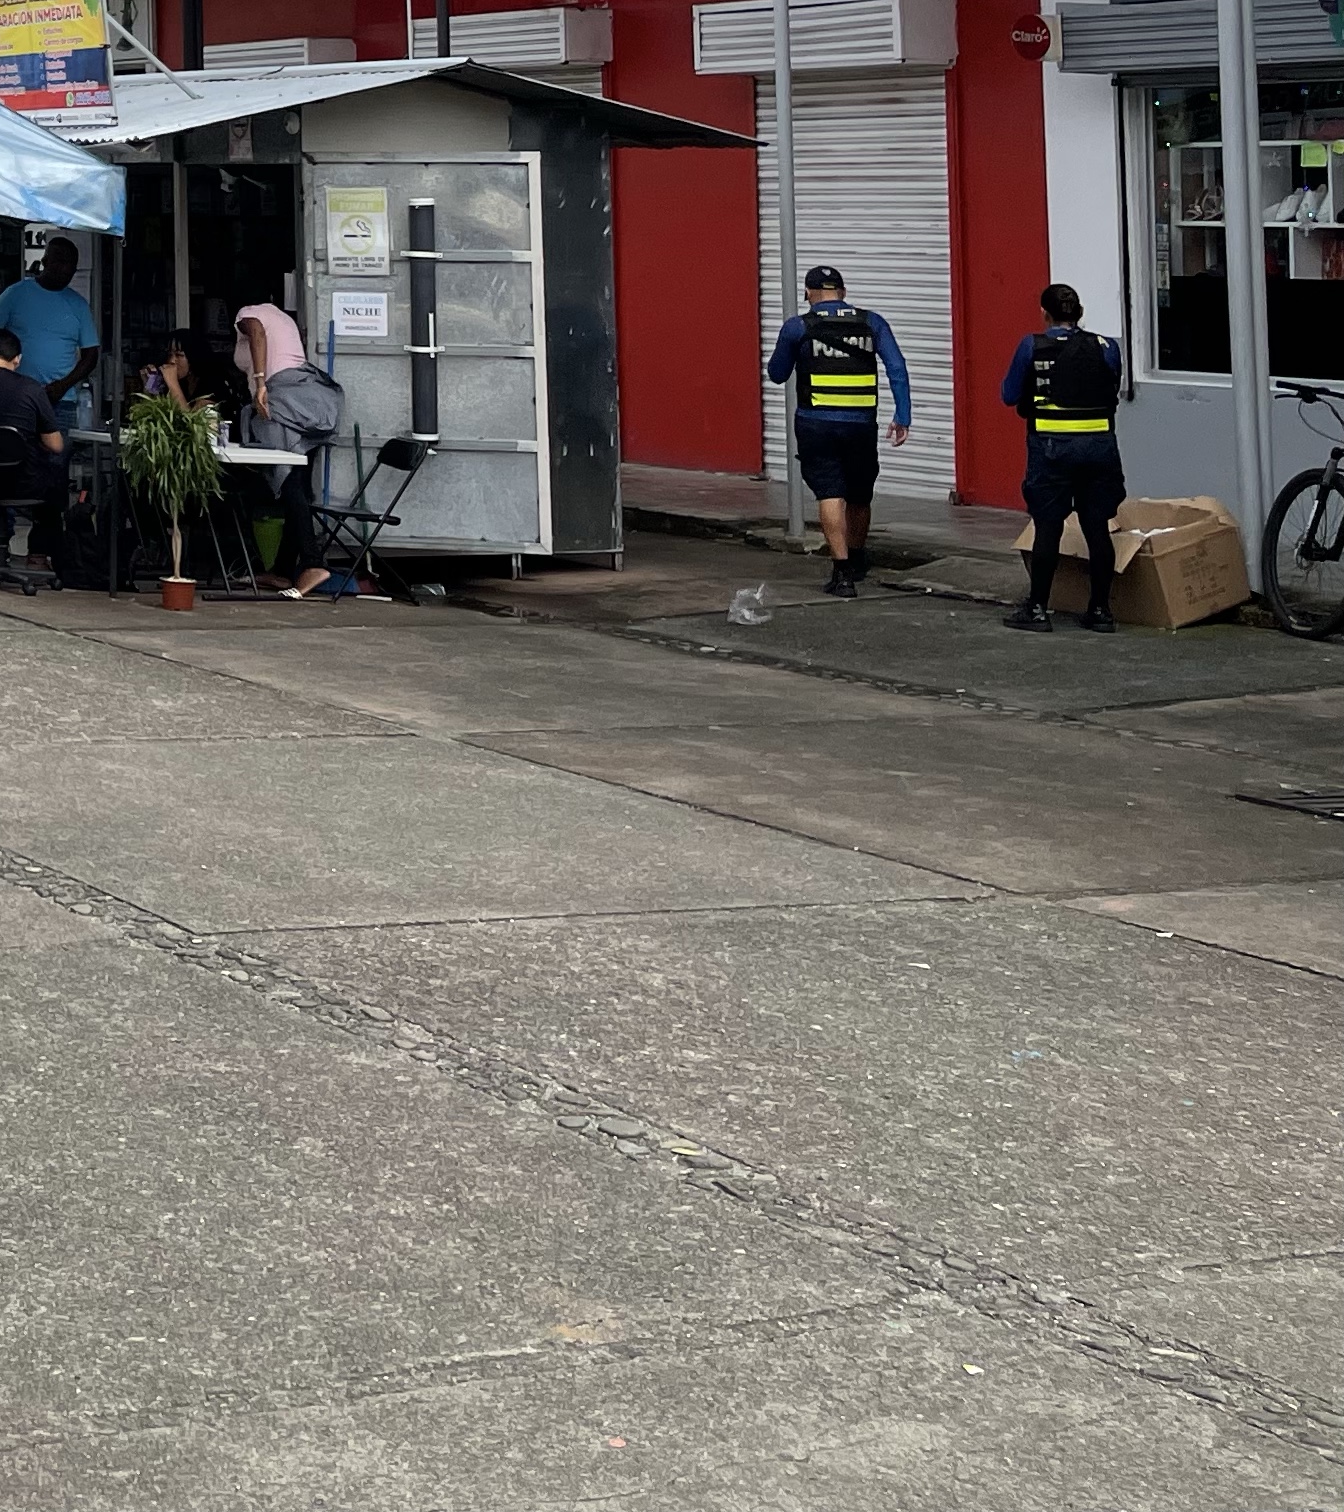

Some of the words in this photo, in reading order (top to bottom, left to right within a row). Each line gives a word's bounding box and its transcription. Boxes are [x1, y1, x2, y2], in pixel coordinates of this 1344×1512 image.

[34, 5, 84, 23] INMEDIATA
[1012, 30, 1043, 43] Claro
[342, 307, 382, 316] NICHE
